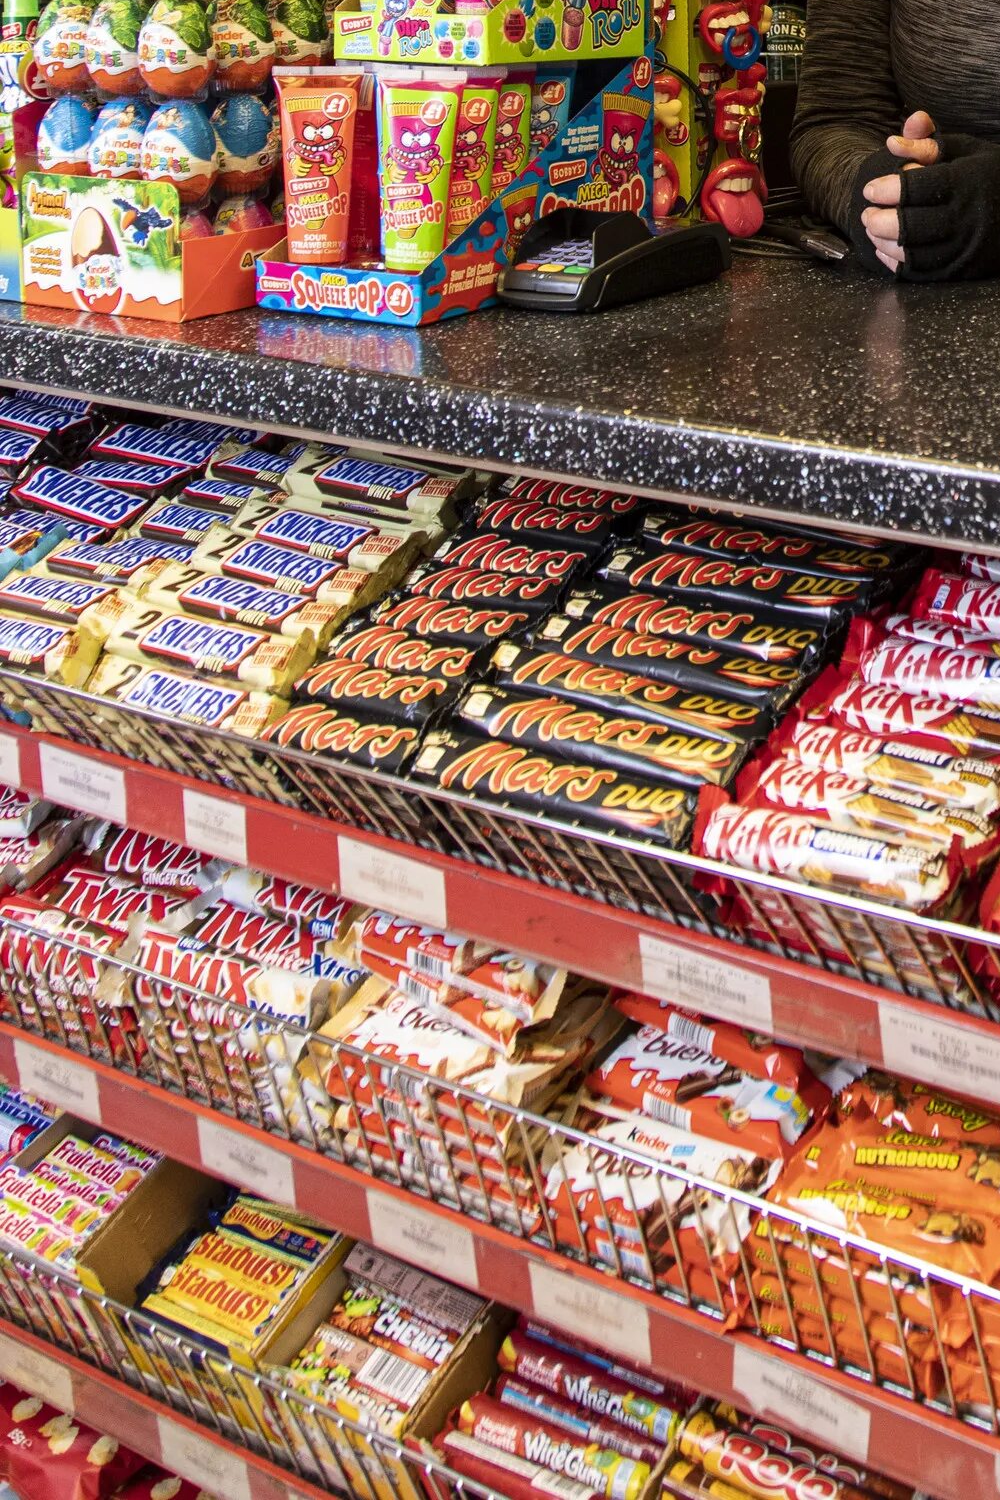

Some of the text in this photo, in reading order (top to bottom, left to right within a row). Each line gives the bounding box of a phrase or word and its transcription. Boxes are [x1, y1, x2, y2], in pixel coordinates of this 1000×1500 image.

[304, 234, 327, 244] SOUR
[293, 275, 408, 310] SQUEEZE POP £1
[30, 466, 143, 520] SNICKERS
[361, 544, 395, 555] EDITION
[367, 535, 400, 546] LIMITED
[148, 619, 260, 664] SNICKERS
[332, 627, 476, 676] Mars
[442, 743, 684, 814] Mars DUO
[643, 1036, 728, 1068] bueno
[627, 1125, 671, 1152] kinder
[54, 1140, 120, 1183] Fruit-tella
[855, 1147, 959, 1170] NUTRAGEOUS
[196, 1232, 297, 1283] Starburst
